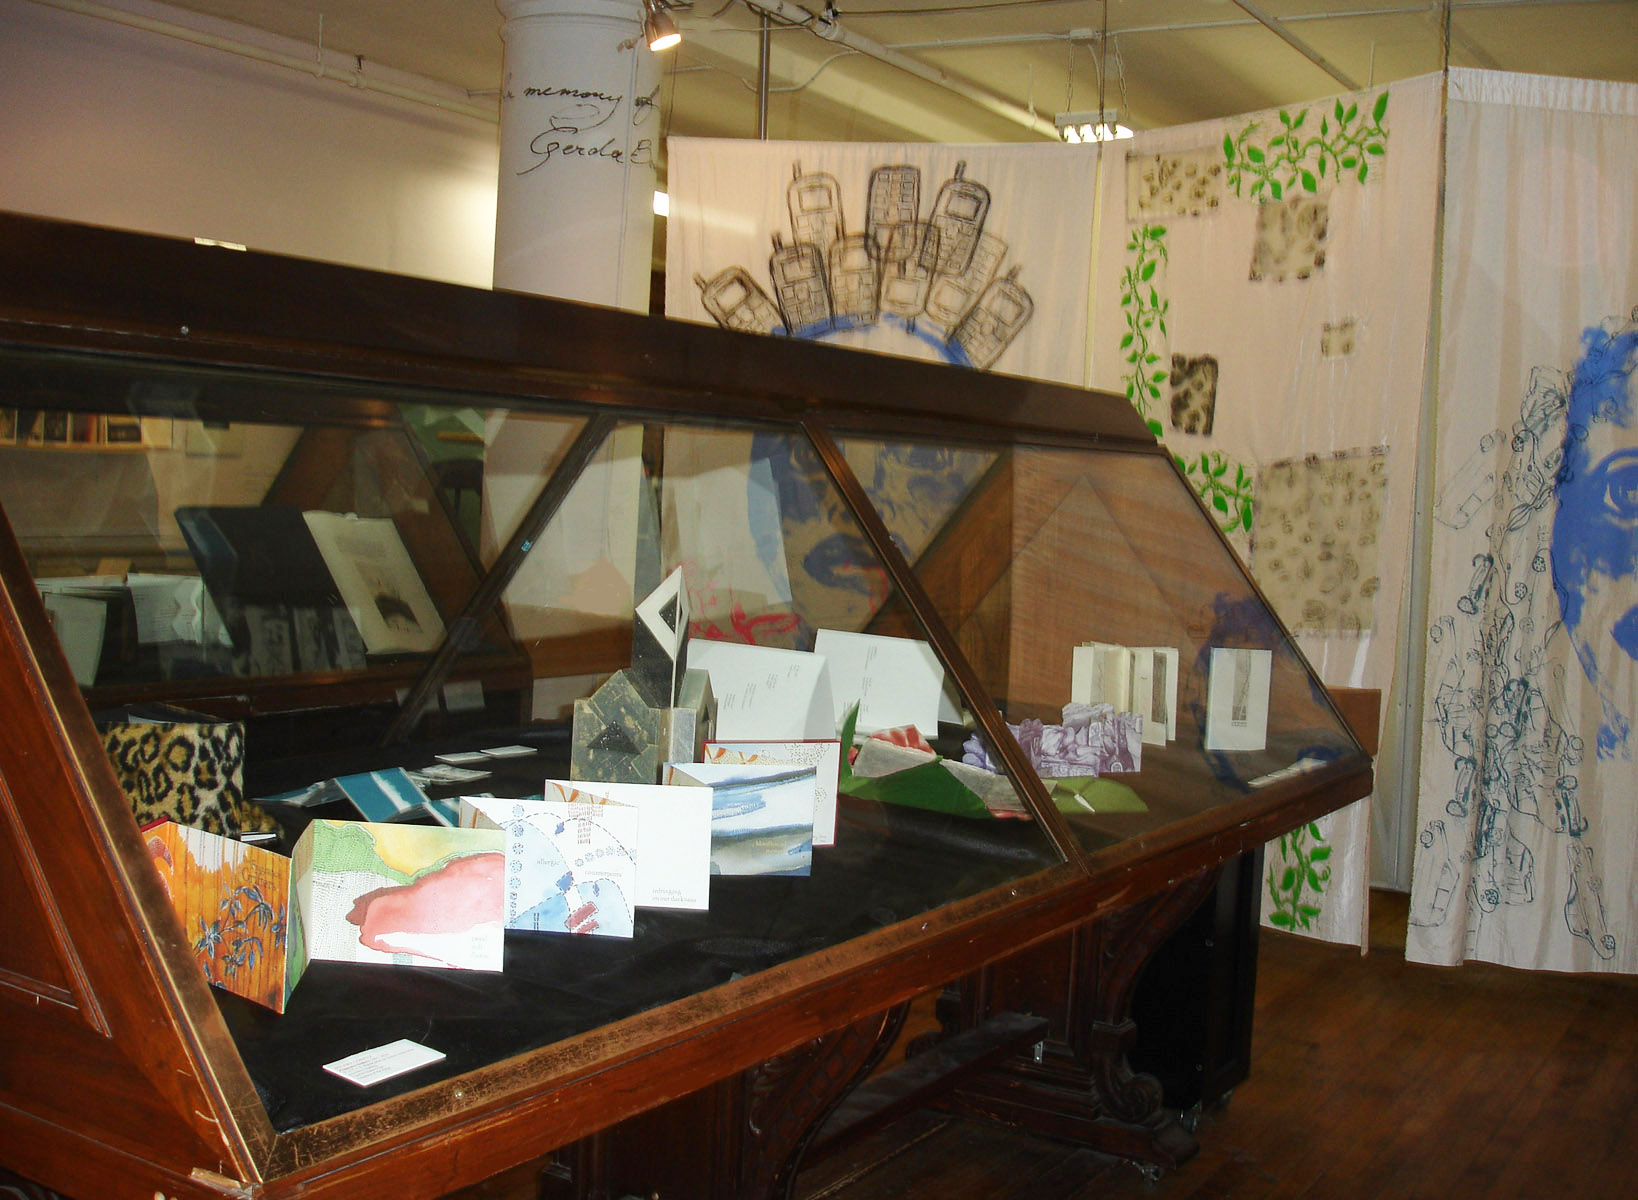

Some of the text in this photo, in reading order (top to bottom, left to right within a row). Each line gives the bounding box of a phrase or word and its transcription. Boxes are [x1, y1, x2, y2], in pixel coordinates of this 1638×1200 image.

[522, 86, 623, 132] memory
[516, 126, 624, 176] Gerda
[536, 857, 561, 867] allergic
